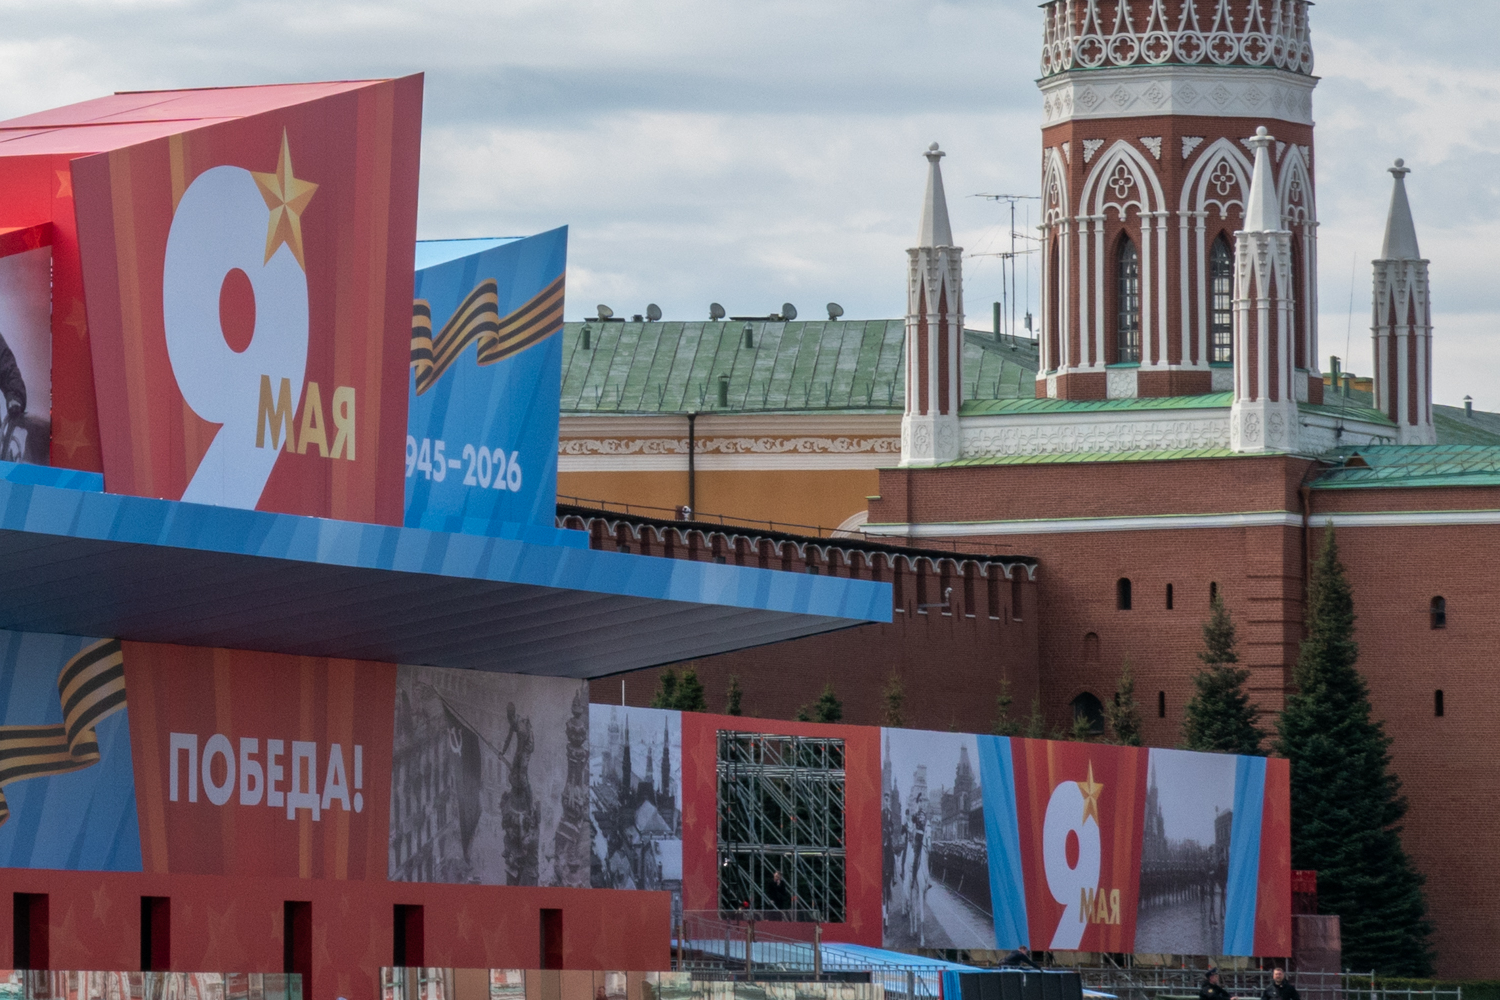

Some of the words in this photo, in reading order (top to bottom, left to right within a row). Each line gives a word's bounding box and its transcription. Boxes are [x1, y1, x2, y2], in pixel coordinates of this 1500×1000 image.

[164, 165, 309, 510] 9
[256, 374, 356, 461] МАЯ
[405, 434, 522, 493] 945-2026
[169, 731, 365, 822] ПОБЕДА!
[1043, 780, 1101, 950] 9
[1079, 887, 1121, 925] МАЯ
